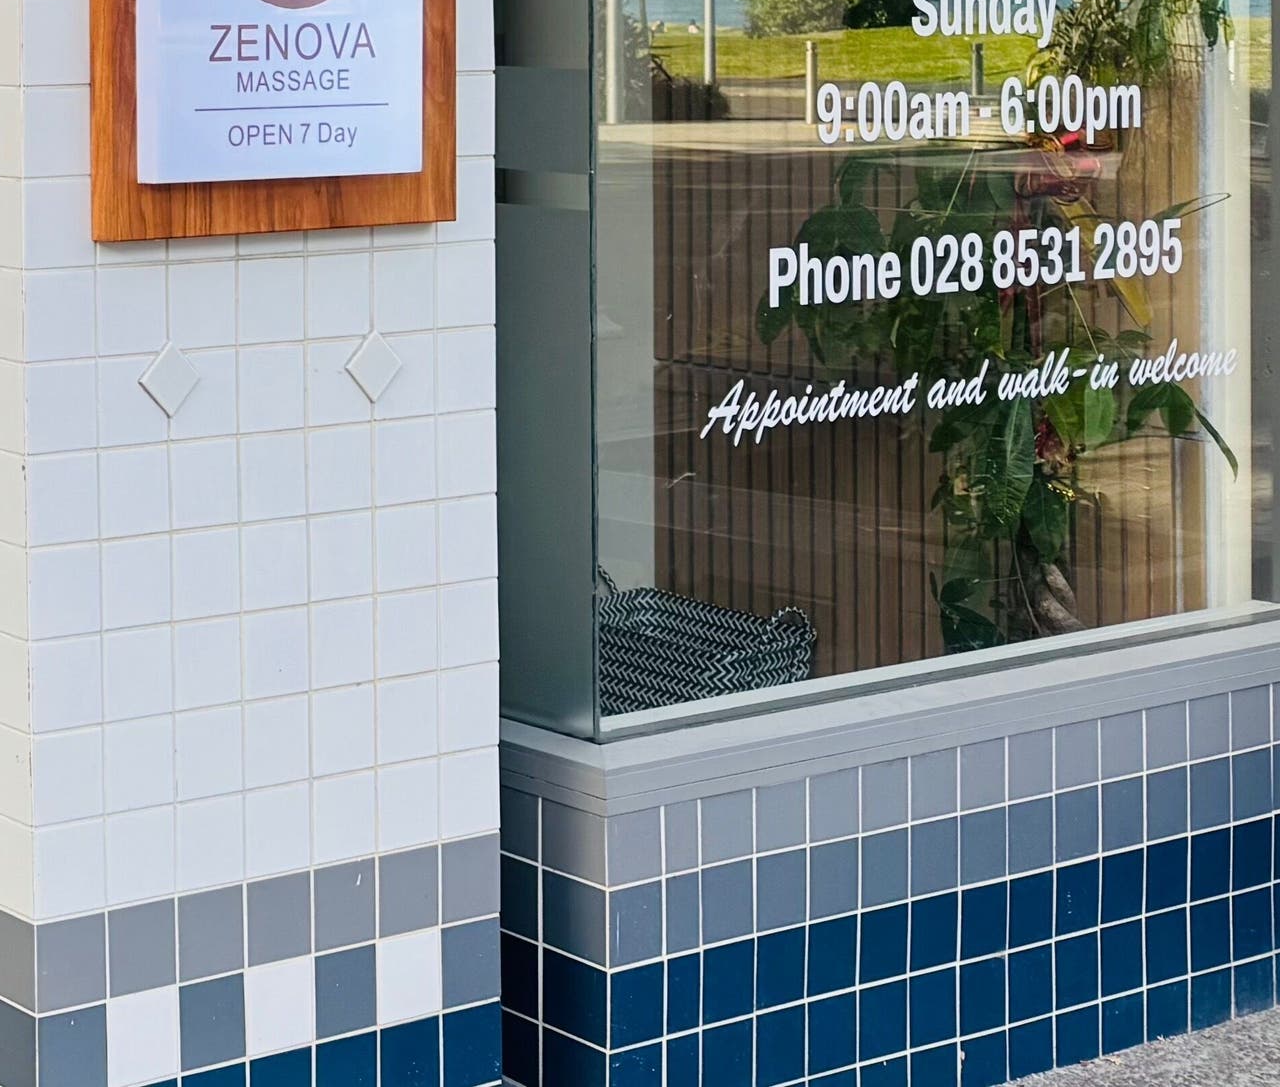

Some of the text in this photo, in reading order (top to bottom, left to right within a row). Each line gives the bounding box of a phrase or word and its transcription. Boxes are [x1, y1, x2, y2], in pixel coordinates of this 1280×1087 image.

[208, 22, 377, 63] ZENOVA
[236, 68, 351, 92] MASSAGE
[228, 121, 359, 148] OPEN 7 Day
[817, 80, 971, 145] 9:00am
[1000, 74, 1142, 145] 6:00pm
[768, 218, 1183, 309] Phone 028 8531 2895
[699, 337, 1239, 448] Appointment and walk-in welcome
